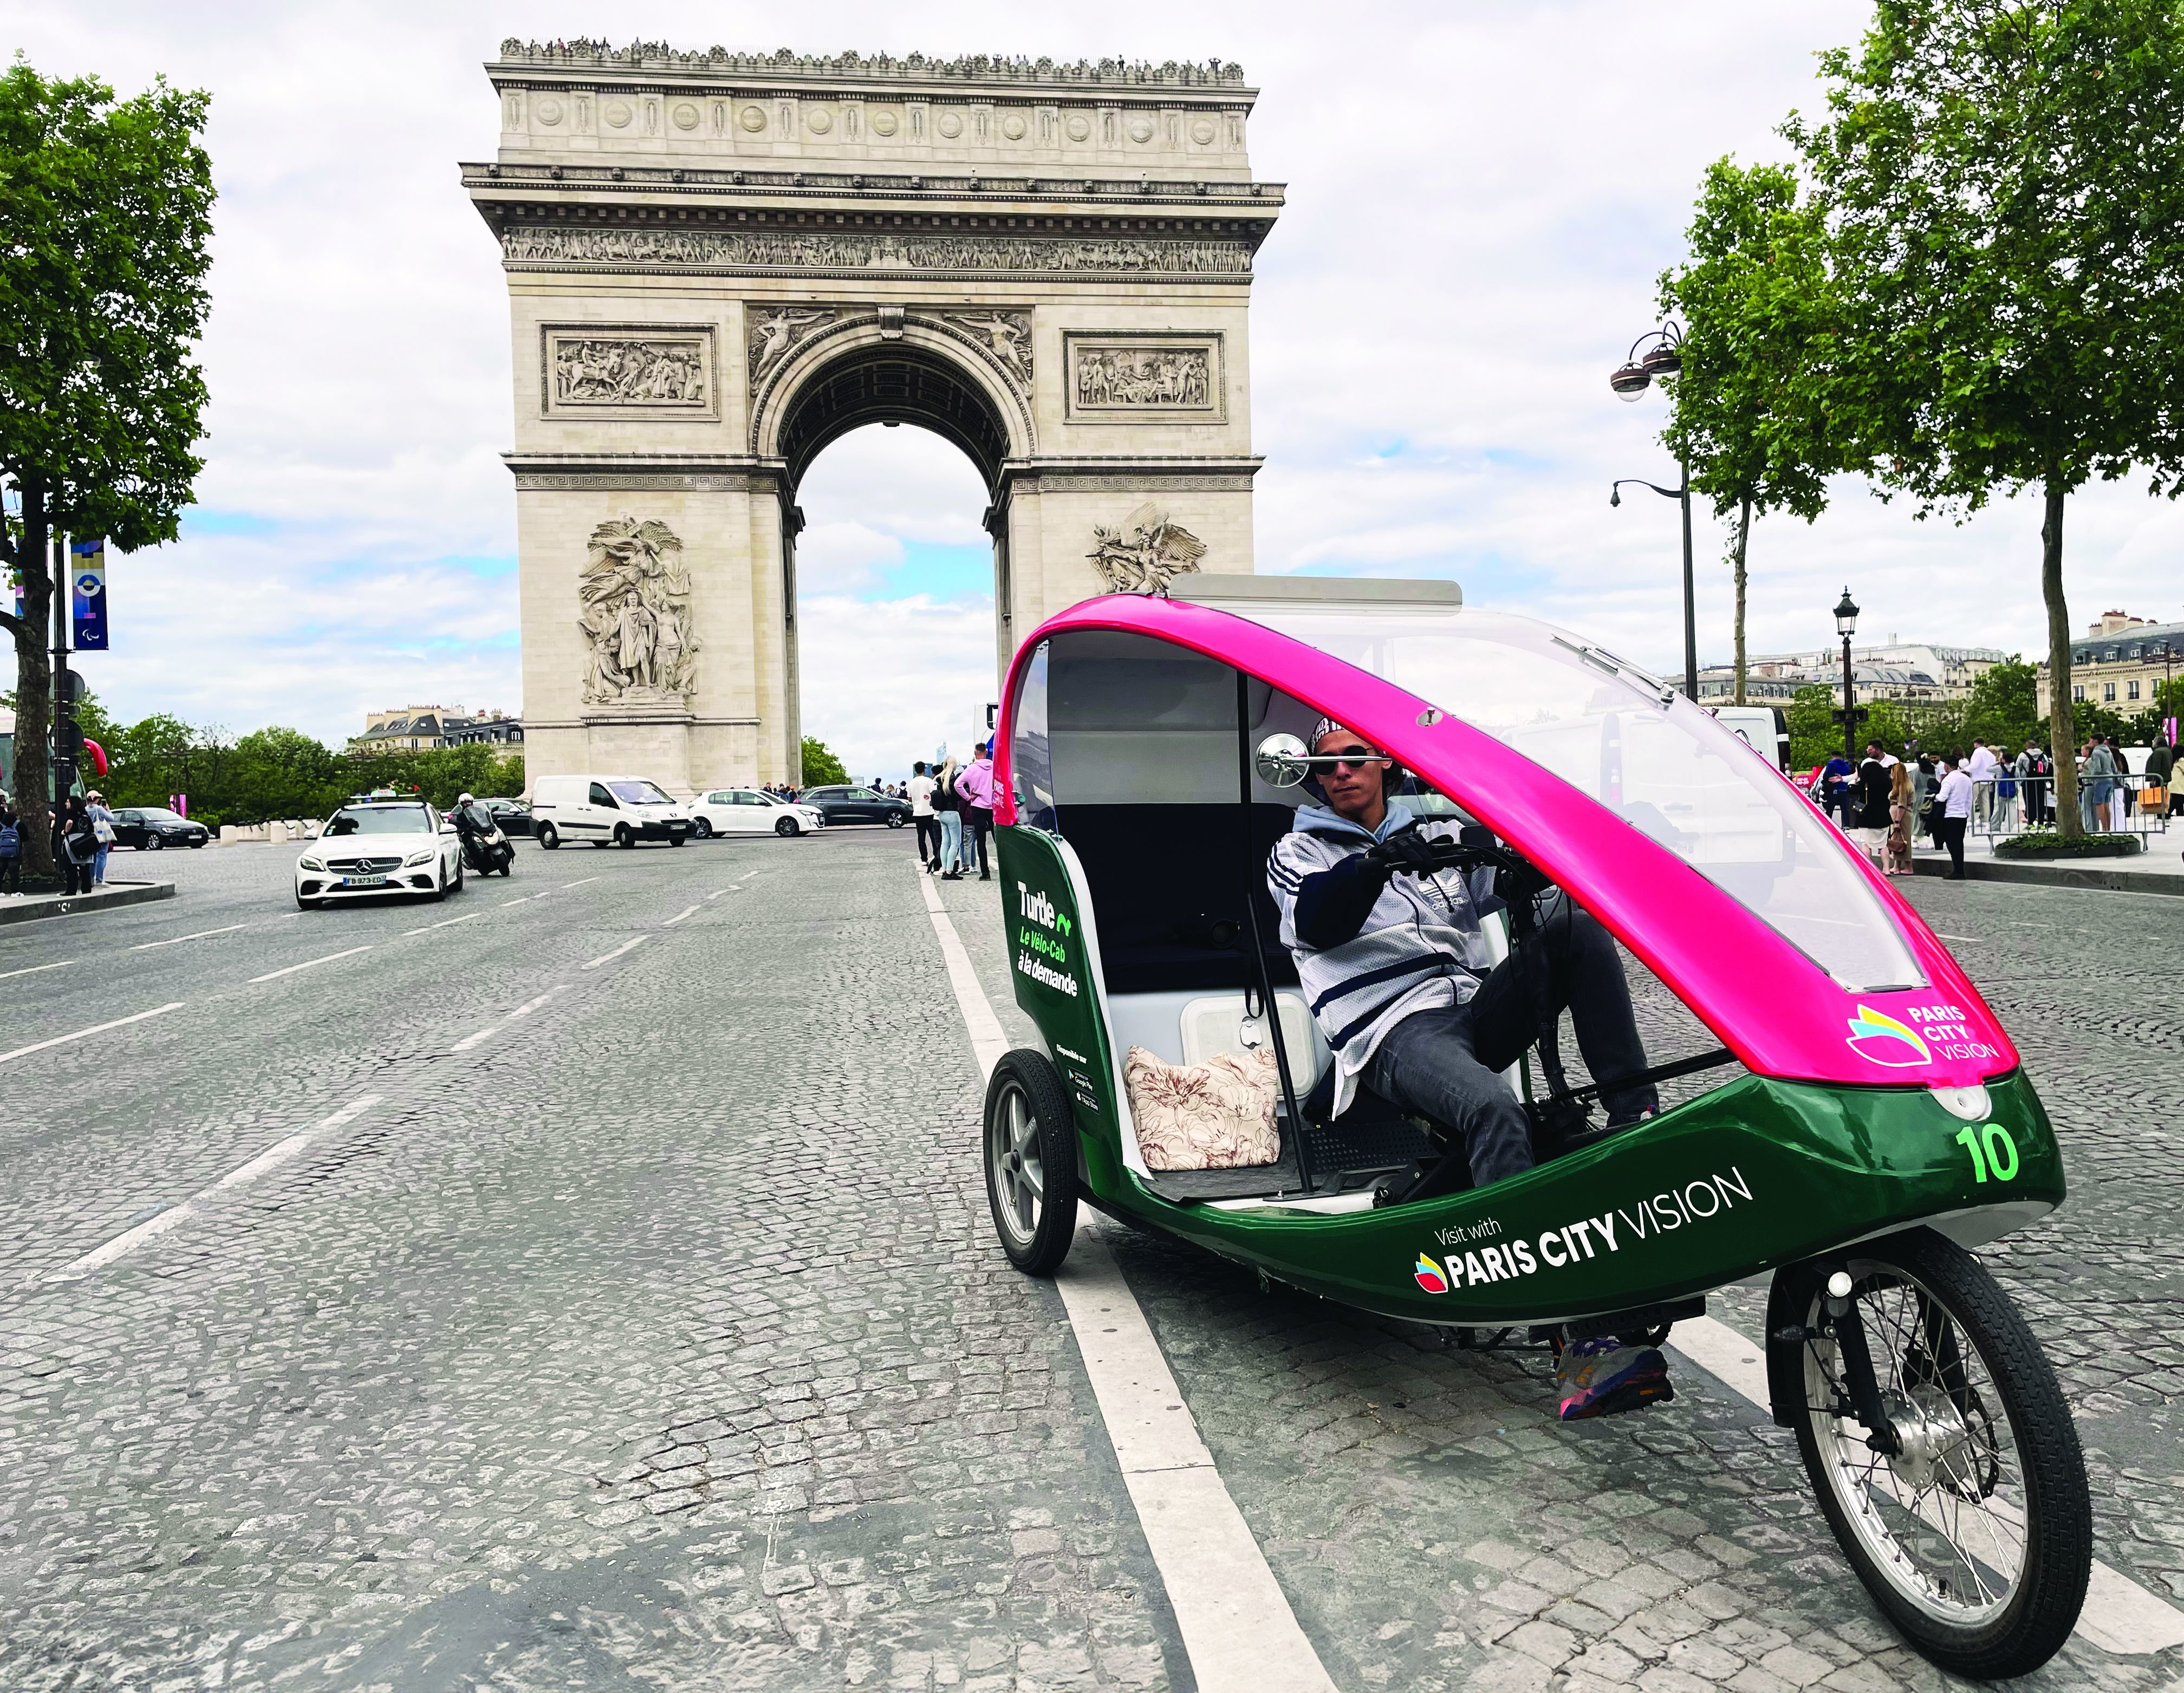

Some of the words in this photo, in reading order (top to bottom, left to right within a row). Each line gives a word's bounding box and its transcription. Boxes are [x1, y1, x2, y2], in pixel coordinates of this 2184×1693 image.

[1018, 881, 1055, 929] Turtle
[1020, 927, 1029, 945] Le
[1031, 930, 1065, 963] Vélo-Cab
[1018, 949, 1024, 971] à
[1023, 953, 1032, 975] la
[1032, 958, 1077, 997] demande
[1907, 1005, 1966, 1023] PARIS
[1923, 1025, 1969, 1041] CITY
[1057, 1044, 1079, 1060] Disponible
[1079, 1056, 1087, 1064] sur
[1935, 1043, 2000, 1060] VISION
[1955, 1123, 2018, 1183] 10
[1434, 1226, 1467, 1246] Visit
[1467, 1217, 1502, 1239] with
[1444, 1239, 1537, 1288] PARIS
[1539, 1212, 1618, 1267] CITY
[1618, 1166, 1753, 1239] VISION
